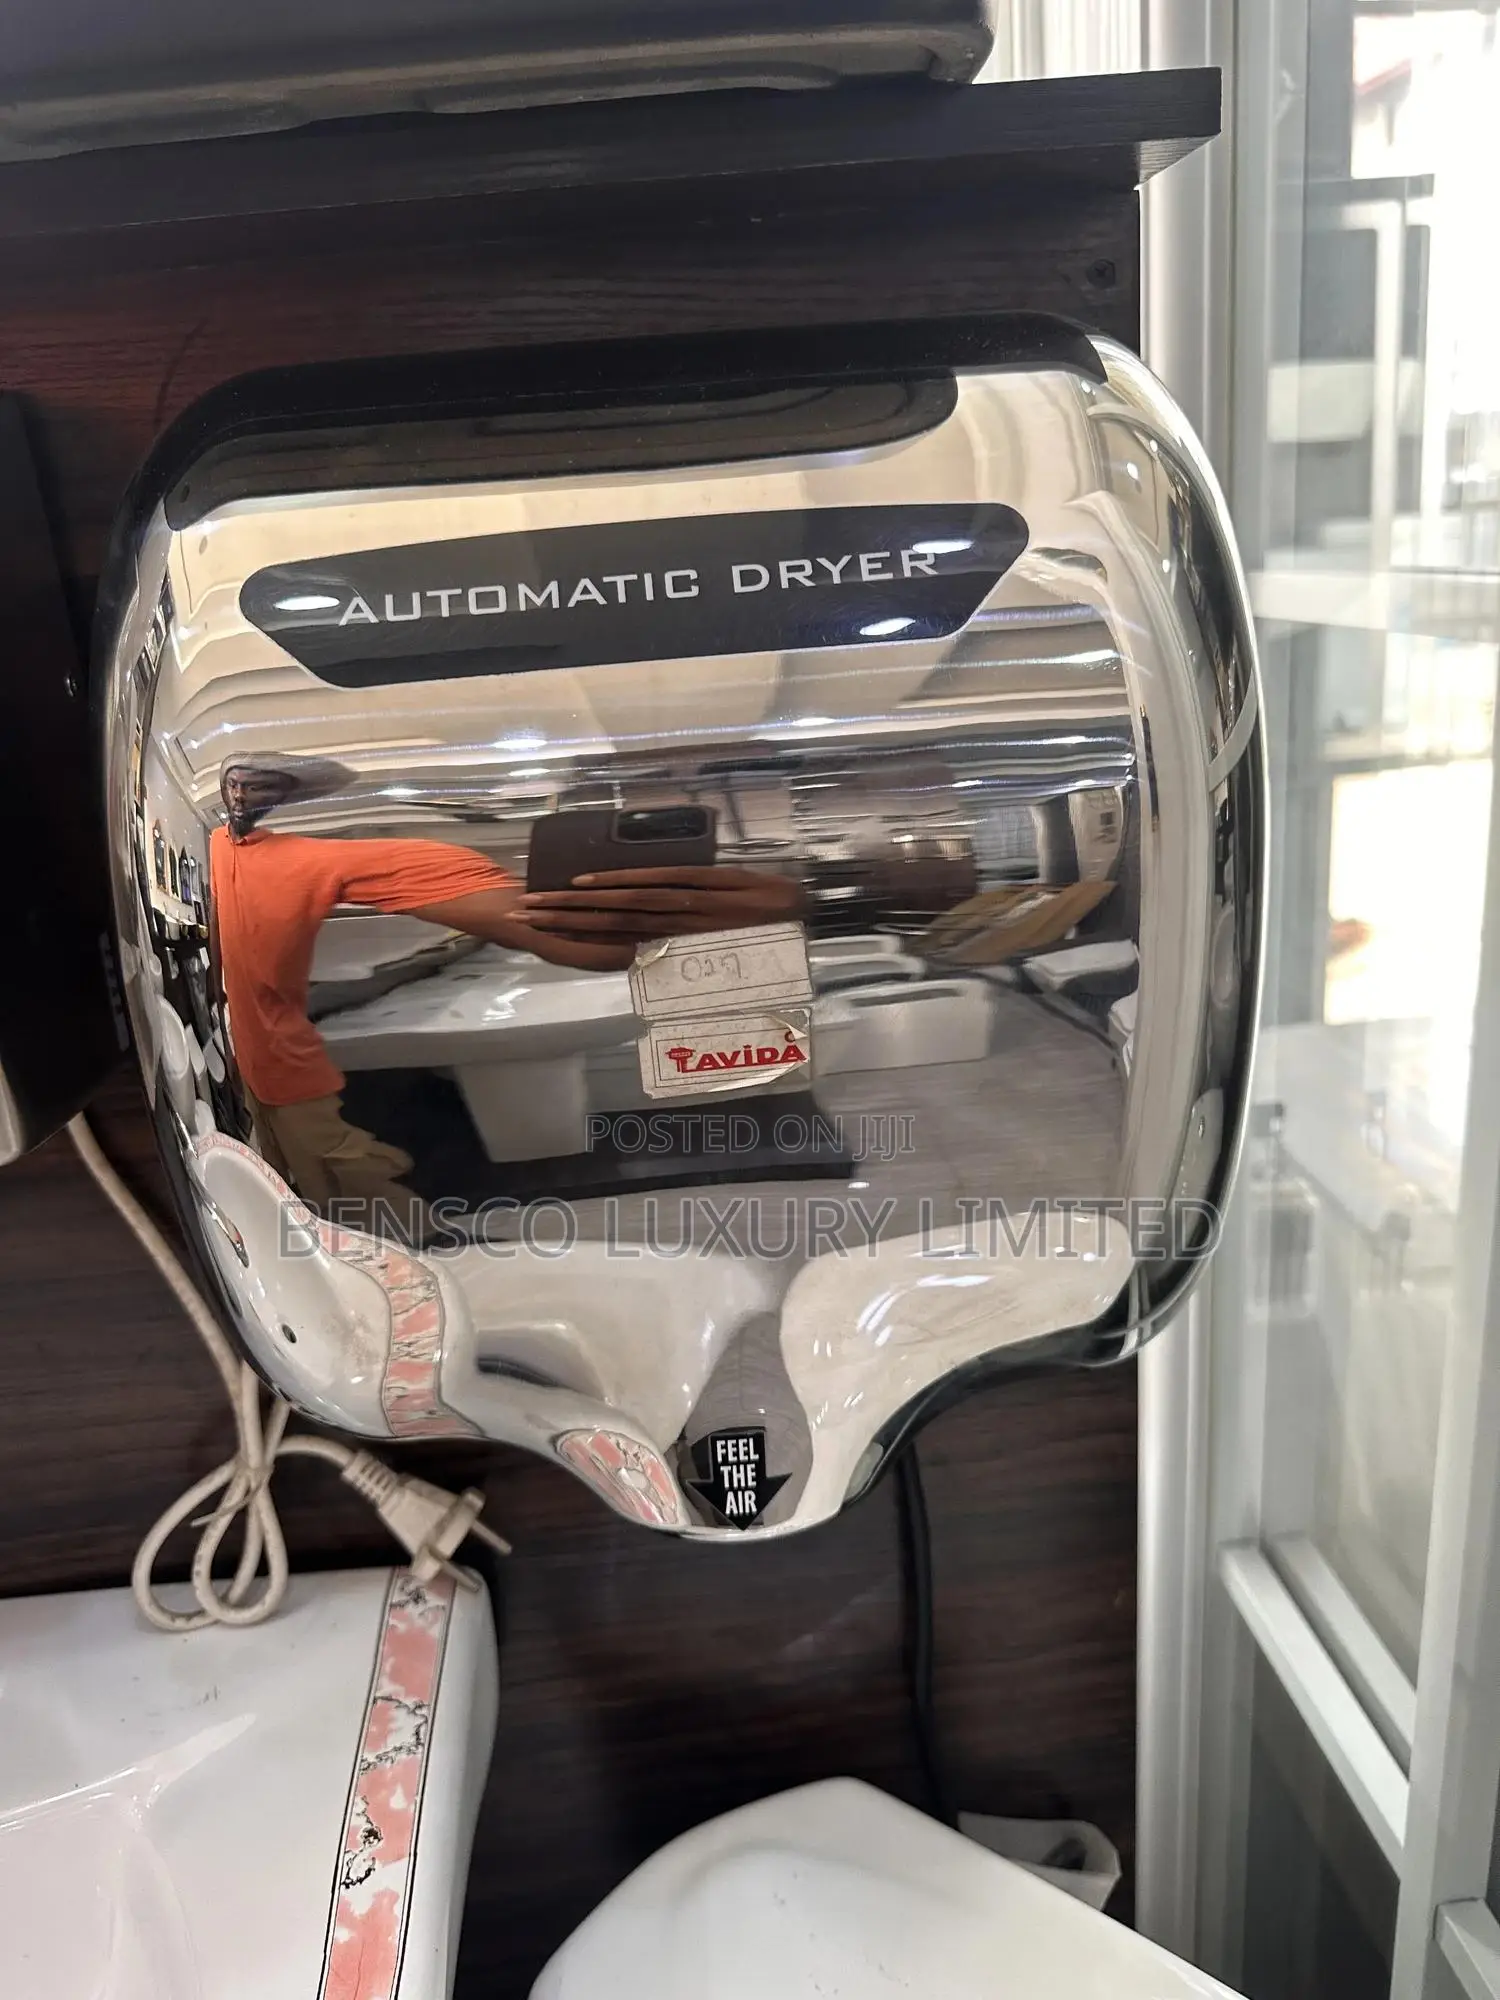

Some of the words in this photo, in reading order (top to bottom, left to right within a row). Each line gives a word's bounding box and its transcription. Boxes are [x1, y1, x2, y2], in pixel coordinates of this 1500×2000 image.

[338, 568, 700, 626] AUTOMATIC
[731, 549, 939, 593] DRYER
[664, 1044, 807, 1074] TAVIDA
[716, 1437, 759, 1462] FEEL
[720, 1463, 757, 1489] THE
[725, 1490, 757, 1515] AIR
